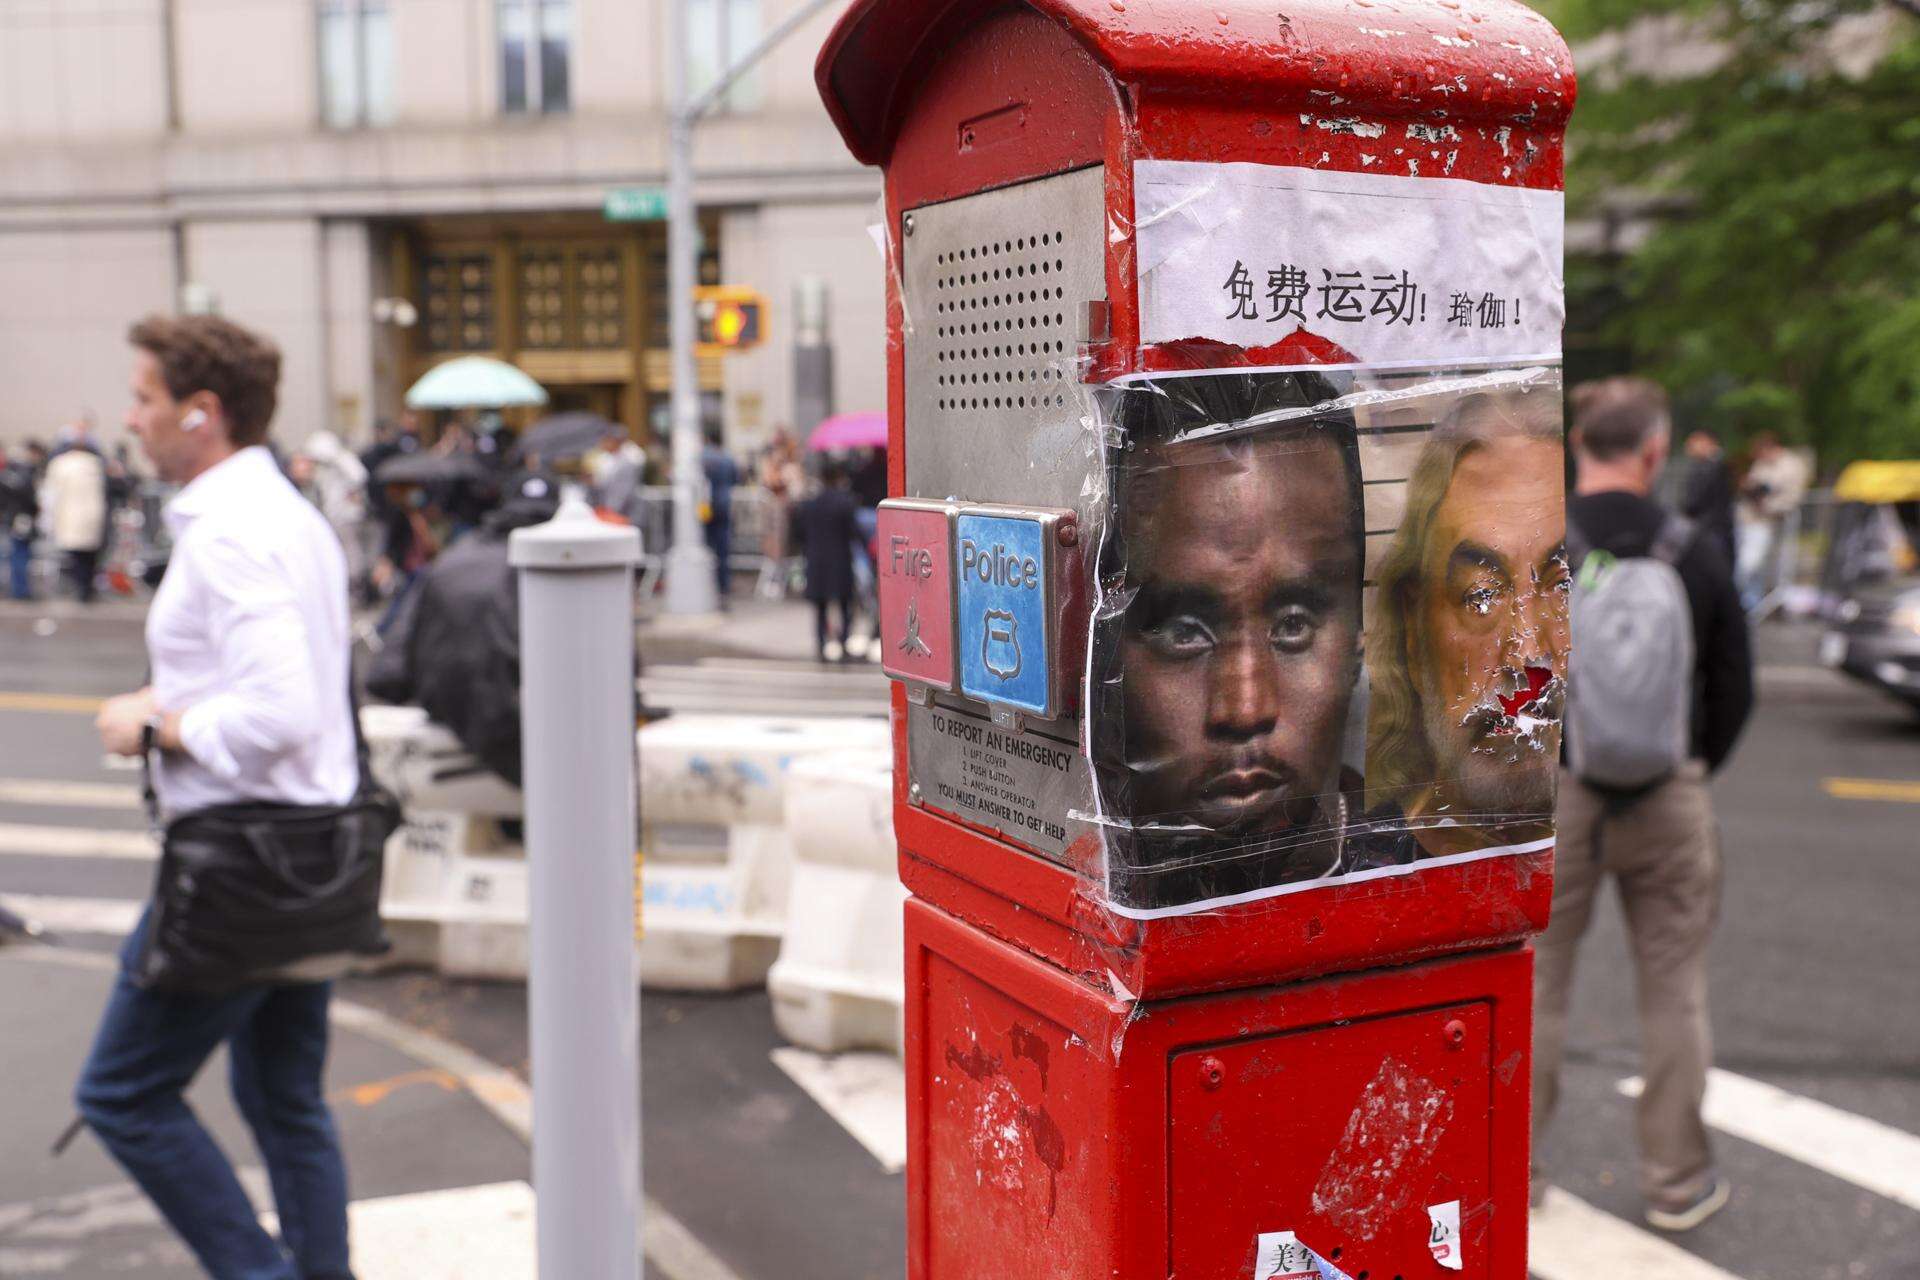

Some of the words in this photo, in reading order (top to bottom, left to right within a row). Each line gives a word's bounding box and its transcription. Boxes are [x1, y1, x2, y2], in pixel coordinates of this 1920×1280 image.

[890, 535, 933, 579] Fire
[960, 538, 1039, 590] Police
[932, 714, 945, 733] TO
[947, 719, 983, 745] REPORT
[986, 731, 1002, 752] AN
[1005, 736, 1072, 773] EMERGENCY
[970, 749, 982, 761] LIFT
[984, 753, 1007, 769] COVER
[970, 763, 987, 778] PUSH
[989, 769, 1016, 787] BUTTON
[970, 780, 998, 797] ANSWER
[1000, 789, 1037, 810] OPERATOR
[938, 782, 954, 799] YOU
[956, 788, 976, 808] MUST
[979, 798, 1011, 821] ANSWER
[1013, 809, 1025, 826] TO
[1026, 815, 1042, 833] GET
[1044, 822, 1066, 843] HELP
